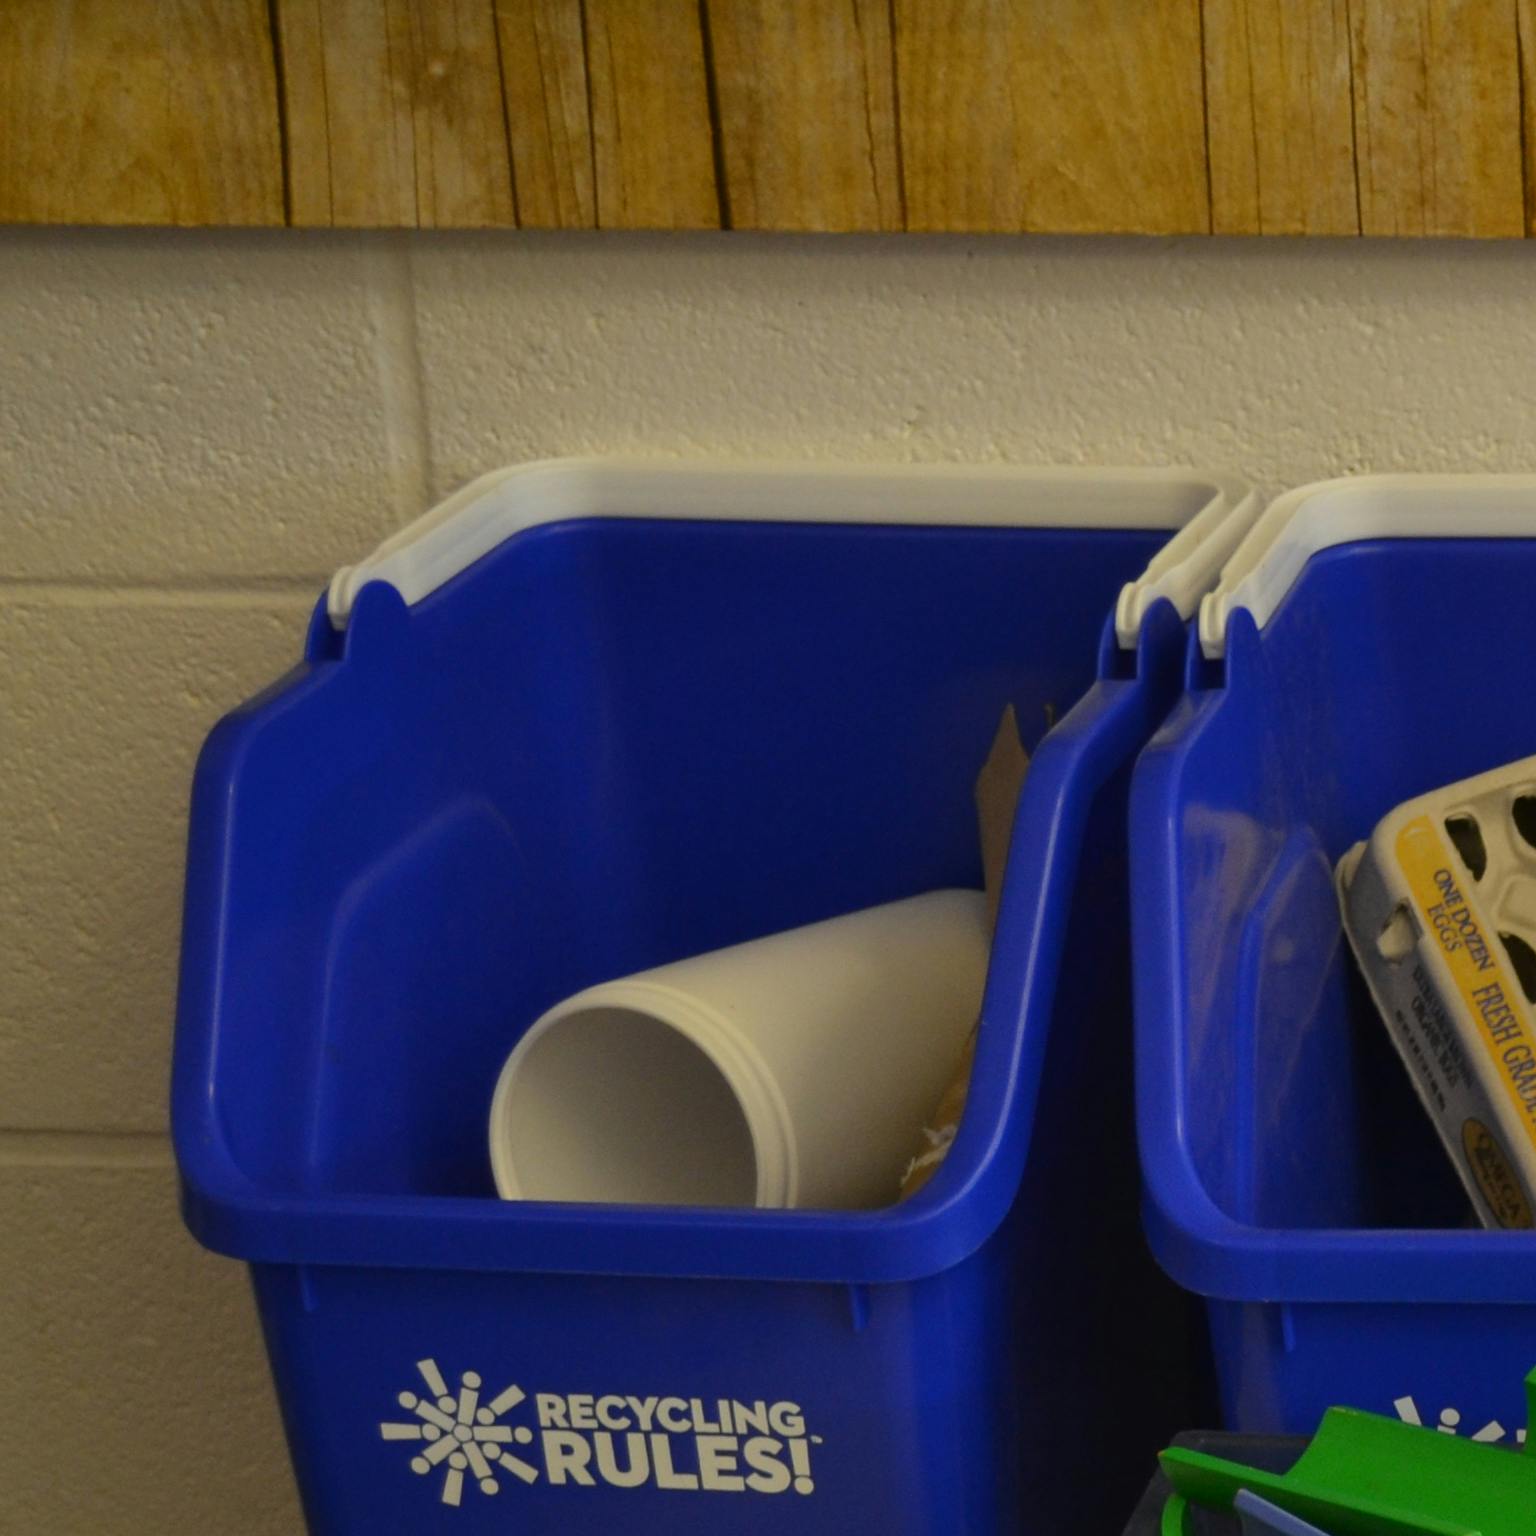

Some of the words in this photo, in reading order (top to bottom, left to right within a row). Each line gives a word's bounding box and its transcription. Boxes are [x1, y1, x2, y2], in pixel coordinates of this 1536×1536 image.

[1427, 903, 1462, 953] EGGS
[1433, 868, 1463, 906] ONE
[1452, 907, 1495, 971] DOZEN
[1472, 982, 1523, 1045] FRESH
[536, 1392, 805, 1437] RECYCLING
[541, 1430, 815, 1495] RULES!
